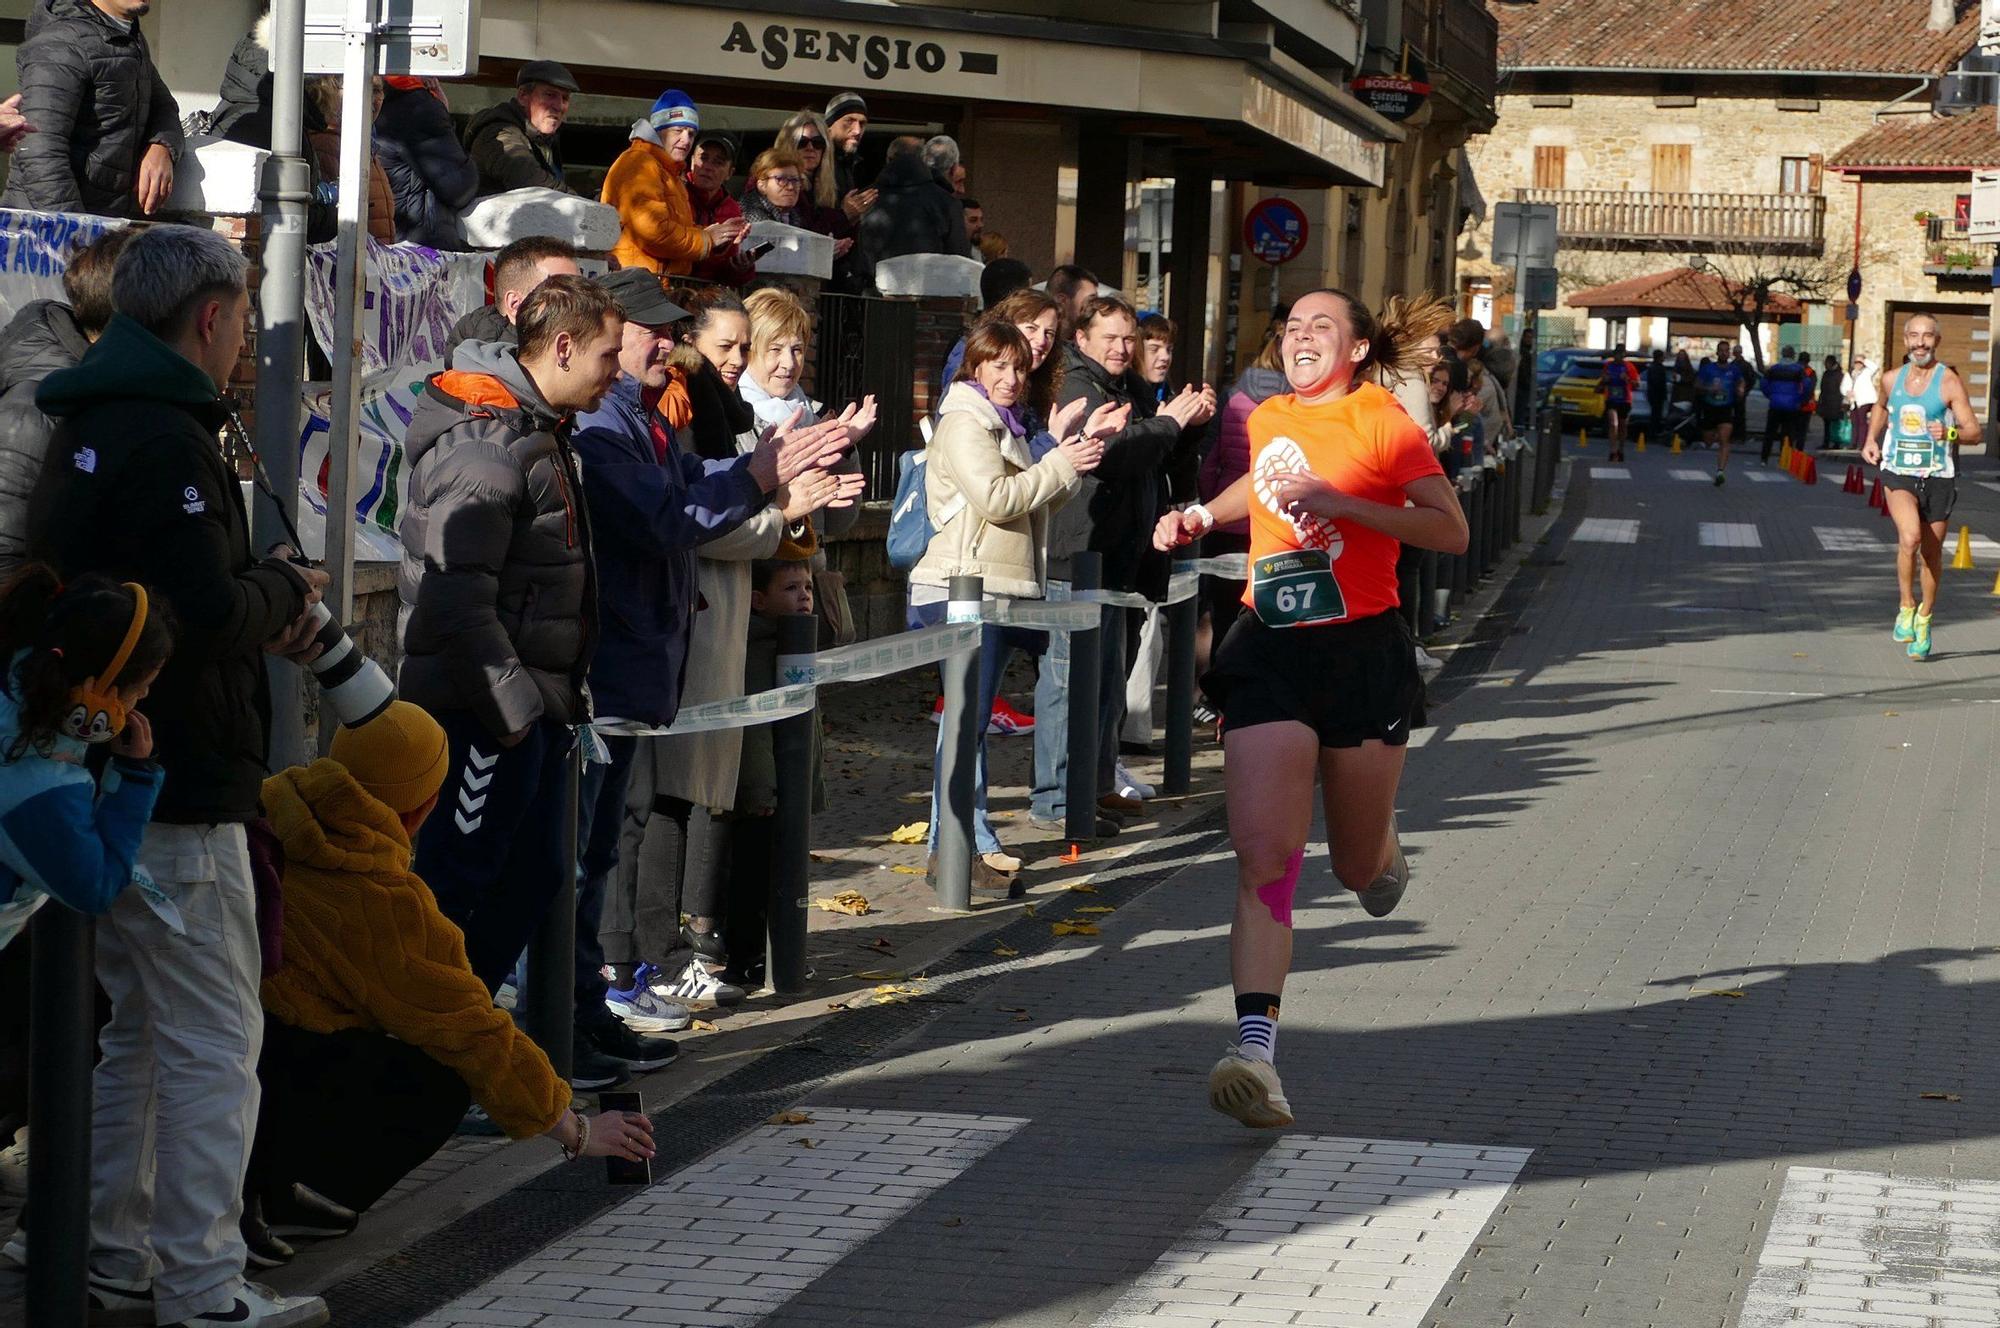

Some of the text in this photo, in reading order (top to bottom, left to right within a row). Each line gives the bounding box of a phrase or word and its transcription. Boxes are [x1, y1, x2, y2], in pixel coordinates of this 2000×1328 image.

[720, 21, 946, 80] ASENSIO
[1364, 80, 1413, 91] BODEGA
[1370, 90, 1408, 102] Estrella
[1903, 452, 1923, 466] 86
[1276, 582, 1317, 613] 67
